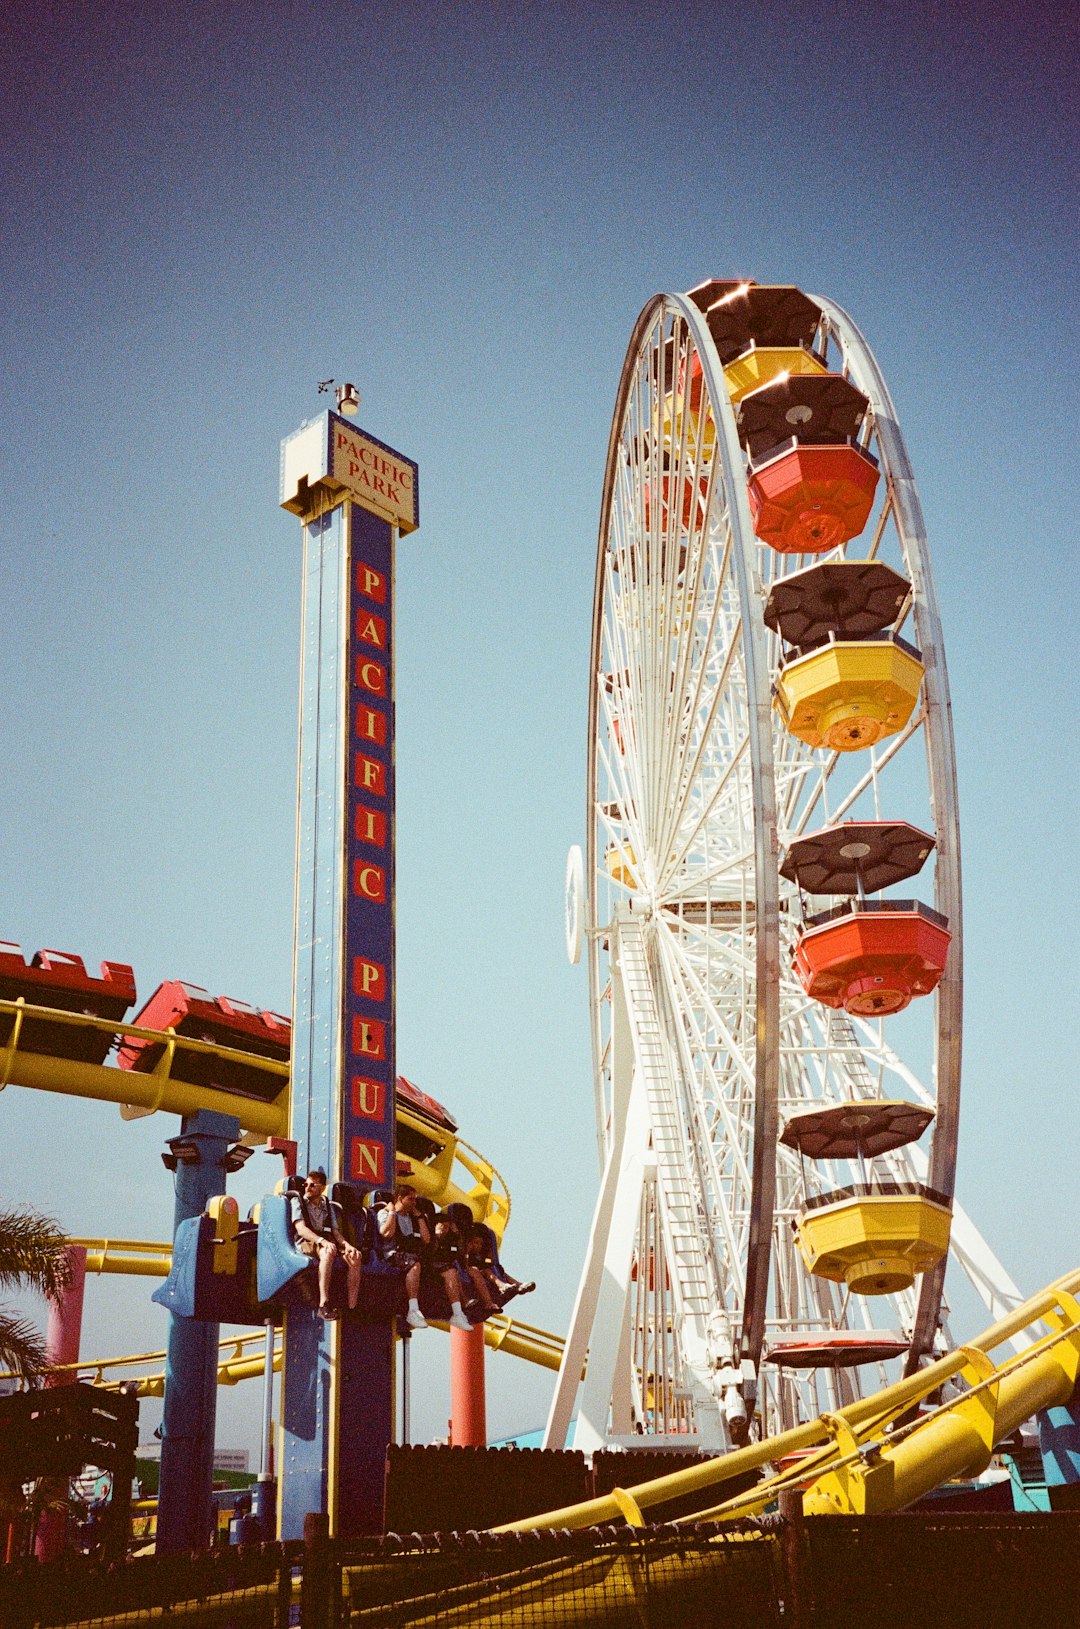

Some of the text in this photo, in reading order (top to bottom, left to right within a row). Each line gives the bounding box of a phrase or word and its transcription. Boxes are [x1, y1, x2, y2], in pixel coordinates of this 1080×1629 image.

[337, 432, 411, 489] PACIFIC
[349, 460, 400, 504] PARK
[360, 568, 381, 896] PACIFIC
